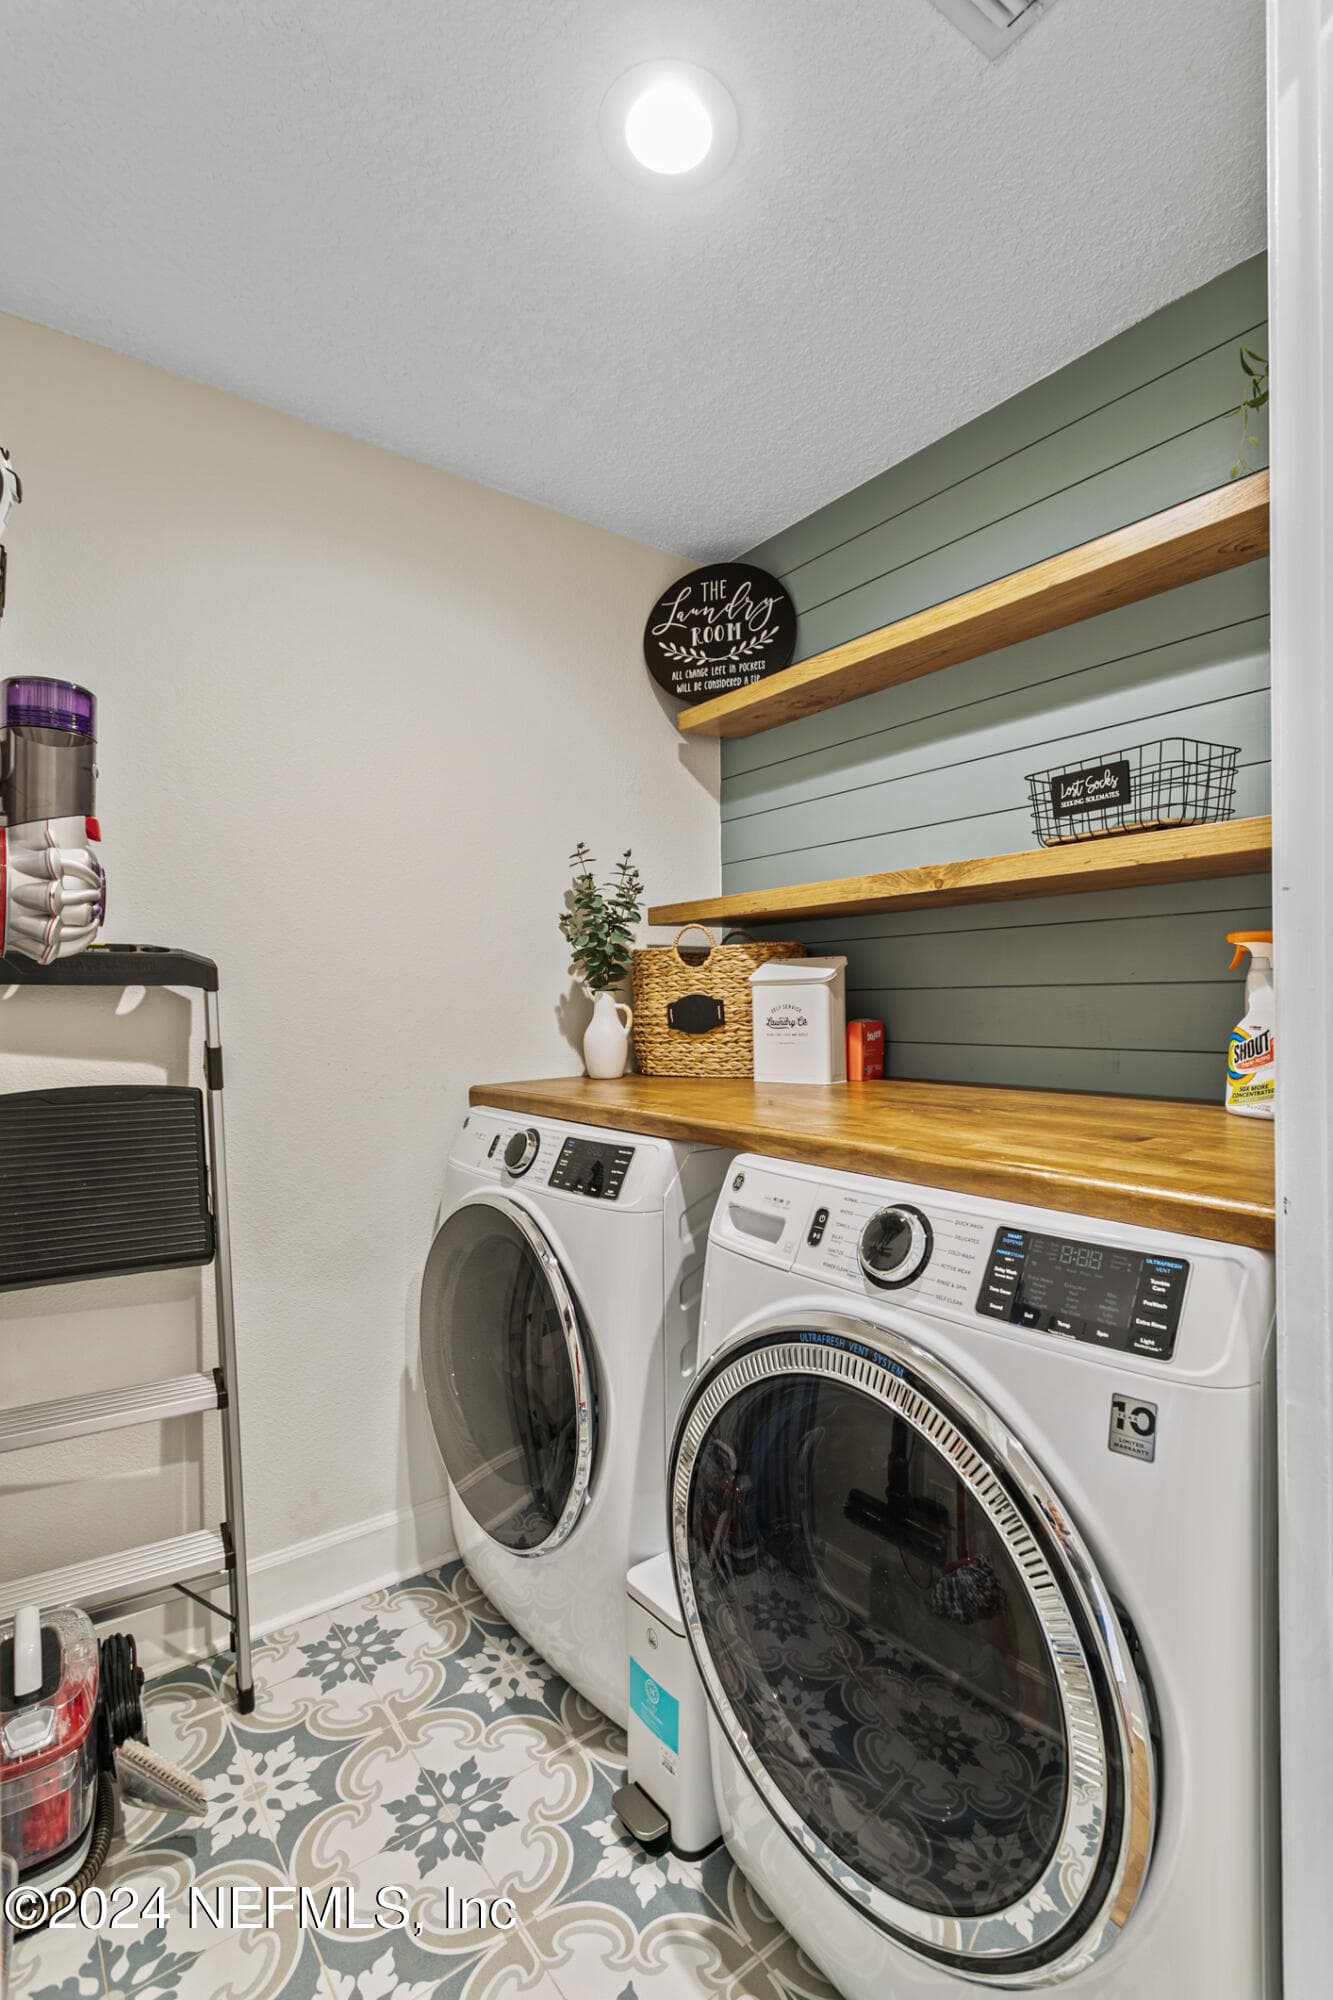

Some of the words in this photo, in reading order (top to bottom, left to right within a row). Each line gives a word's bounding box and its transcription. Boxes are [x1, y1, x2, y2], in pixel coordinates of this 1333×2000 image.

[700, 579, 727, 602] THE
[652, 581, 785, 635] Laundry
[691, 622, 742, 647] ROOM
[671, 670, 682, 681] ALL
[685, 667, 708, 679] CHANGE
[711, 665, 727, 676] LEFT
[739, 660, 766, 672] POCKETS
[676, 683, 692, 693] WILL
[694, 681, 702, 691] BE
[704, 676, 742, 690] CONSIDERED
[743, 676, 749, 685] A
[1060, 780, 1085, 799] Lost
[1085, 769, 1119, 794] Socks
[766, 1016, 795, 1029] Laundry
[1234, 1029, 1269, 1063] SHOUT
[1145, 1258, 1183, 1269] ULTRAFRESH
[800, 1332, 845, 1348] ULTRAFRESH
[848, 1342, 870, 1357] VENT
[872, 1351, 905, 1377] SYSTEM
[1112, 1401, 1156, 1437] 10
[1113, 1442, 1149, 1456] WARRANTY
[1119, 1437, 1144, 1448] LIMITED
